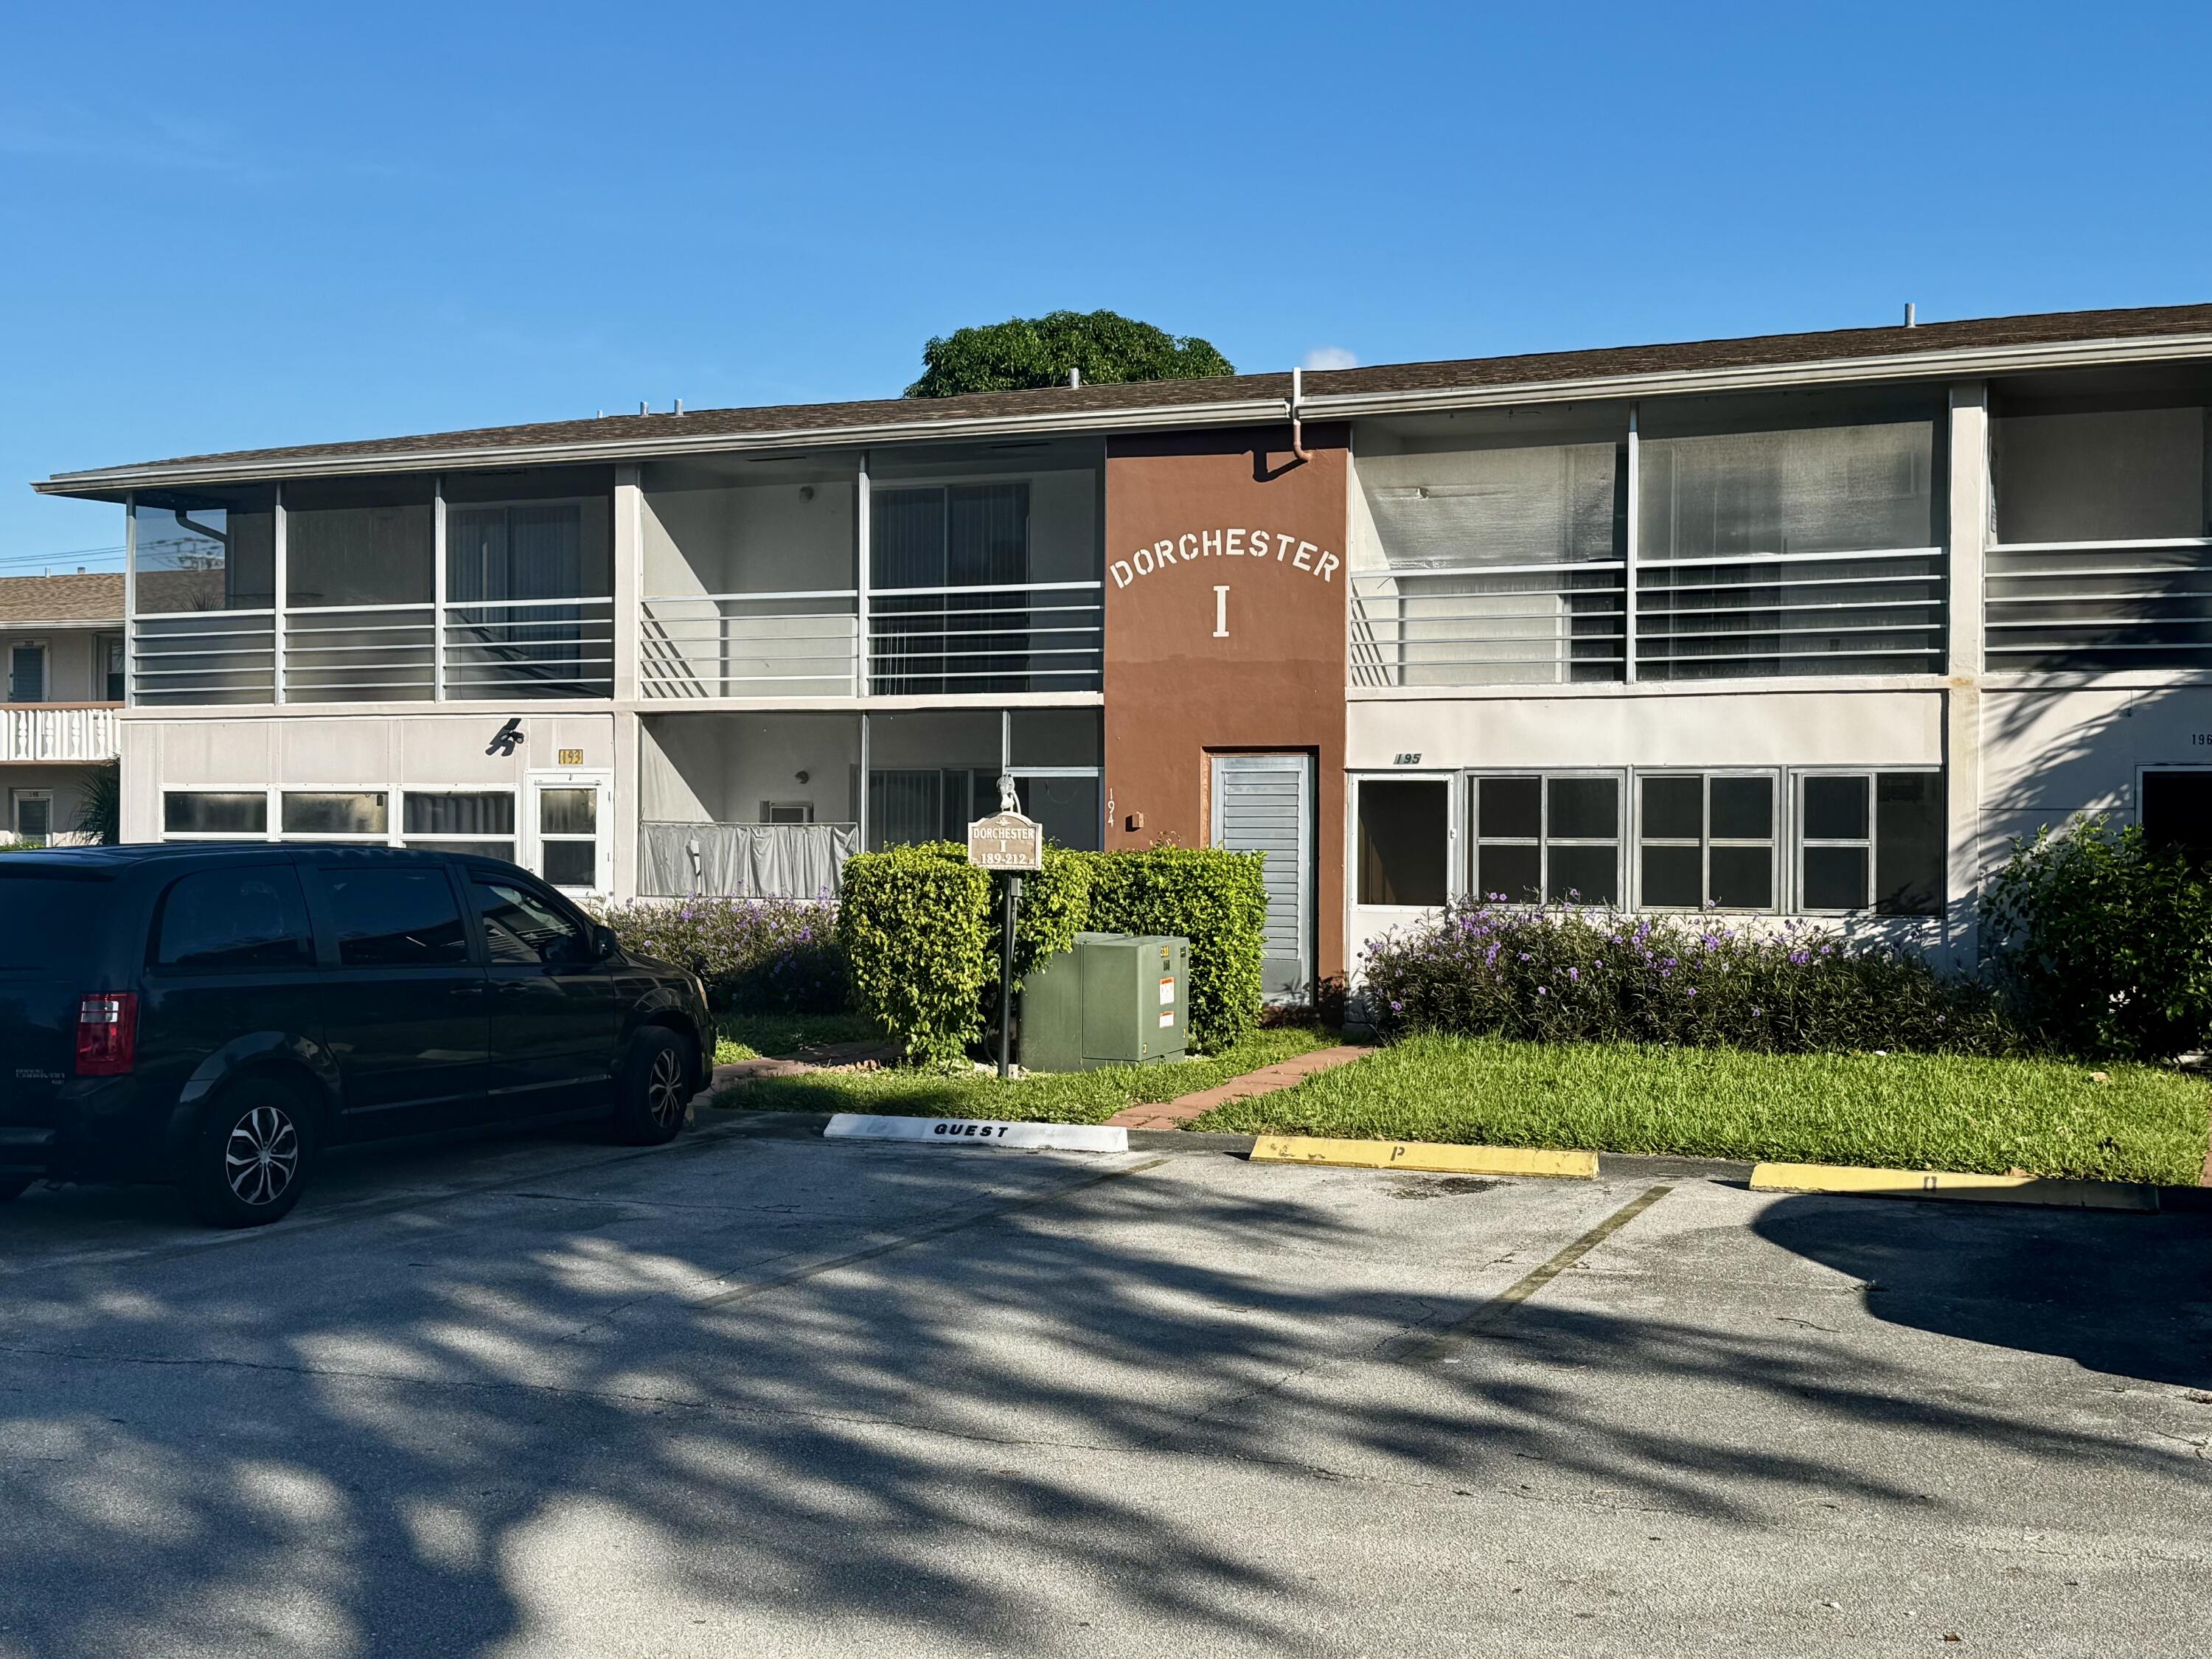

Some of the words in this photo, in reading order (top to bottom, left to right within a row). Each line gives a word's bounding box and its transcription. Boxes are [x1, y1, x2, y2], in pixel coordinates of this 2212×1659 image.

[1110, 528, 1340, 588] DORCHESTER
[1212, 585, 1230, 637] I
[2192, 734, 2212, 745] 196
[562, 749, 582, 764] 193
[1397, 753, 1422, 764] 195
[973, 827, 1035, 839] DORCHESTER
[1000, 840, 1006, 852] I
[981, 853, 1027, 864] 189-212
[934, 1124, 1009, 1137] GUEST
[1390, 1146, 1405, 1161] P
